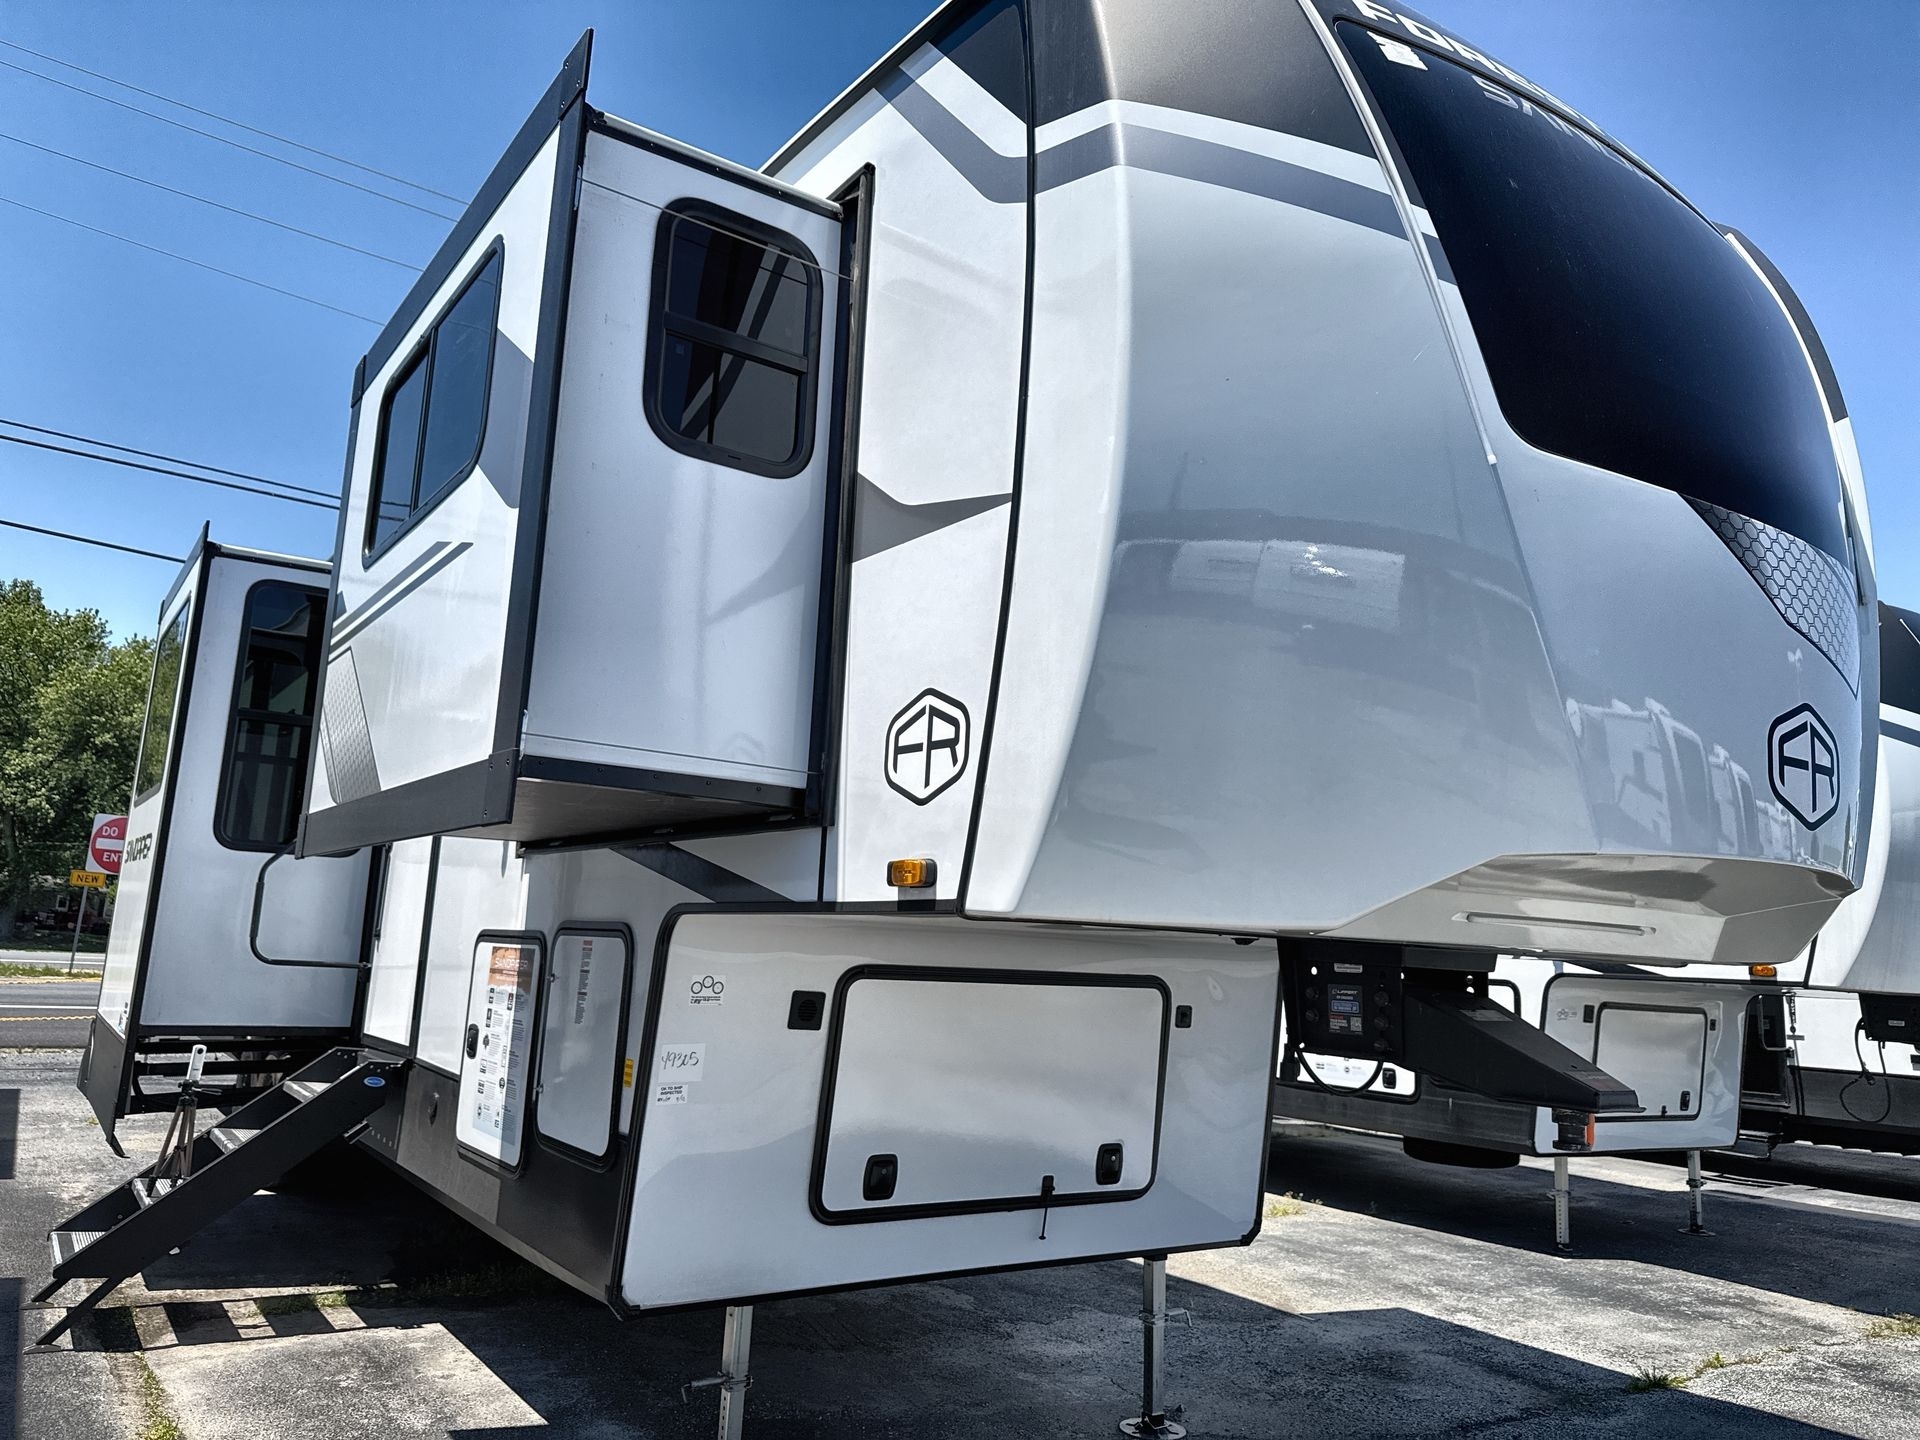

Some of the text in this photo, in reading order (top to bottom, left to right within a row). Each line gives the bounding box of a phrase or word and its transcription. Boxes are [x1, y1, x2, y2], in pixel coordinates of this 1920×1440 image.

[892, 703, 961, 790] FR
[1777, 719, 1835, 814] FR
[102, 826, 118, 836] DO
[103, 852, 123, 862] ENT
[76, 873, 99, 884] NEW
